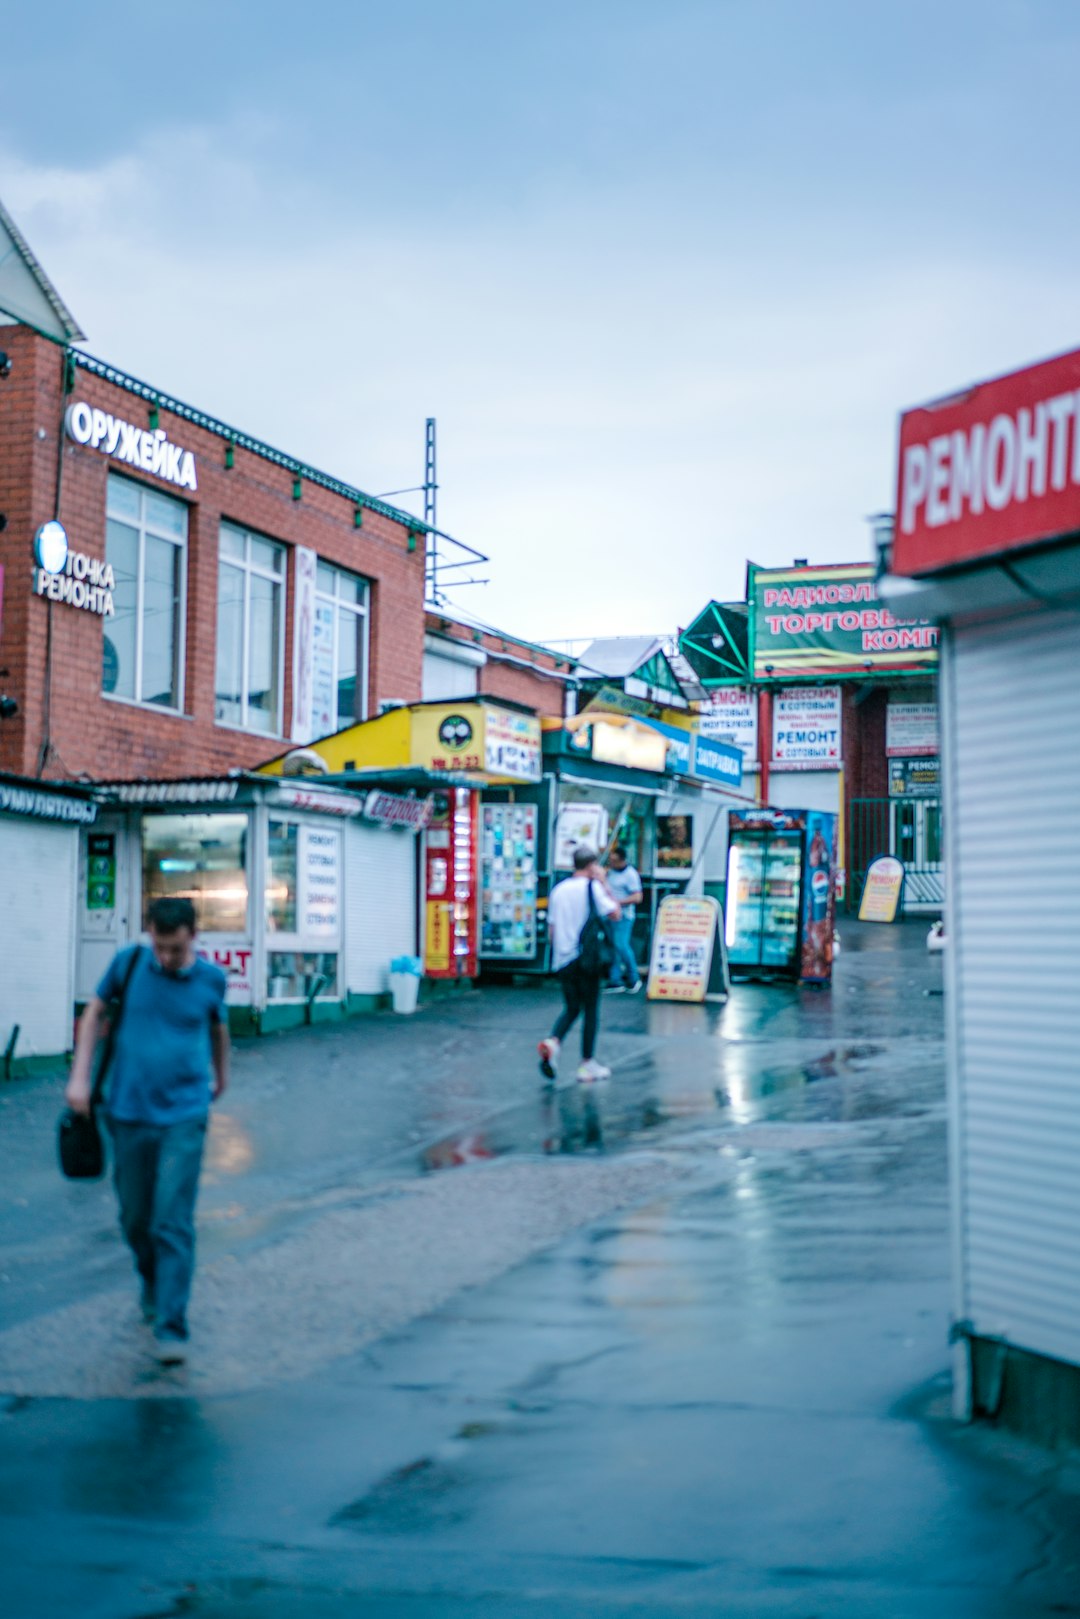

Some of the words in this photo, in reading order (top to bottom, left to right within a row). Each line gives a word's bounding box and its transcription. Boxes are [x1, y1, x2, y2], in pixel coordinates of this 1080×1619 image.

[66, 402, 197, 491] ОРУЖЕЙКА
[901, 388, 1080, 536] РЕМОНТ
[66, 550, 116, 590] ТОЧКА
[36, 568, 115, 617] РЕМОНТА
[764, 582, 878, 608] РАДИОЭЛ
[765, 609, 929, 635] ТОРГОВЫ
[703, 689, 754, 706] ЕМОНТ
[777, 730, 837, 744] РЕМОНТ
[0, 784, 97, 823] УМУЛЯТОРЫ
